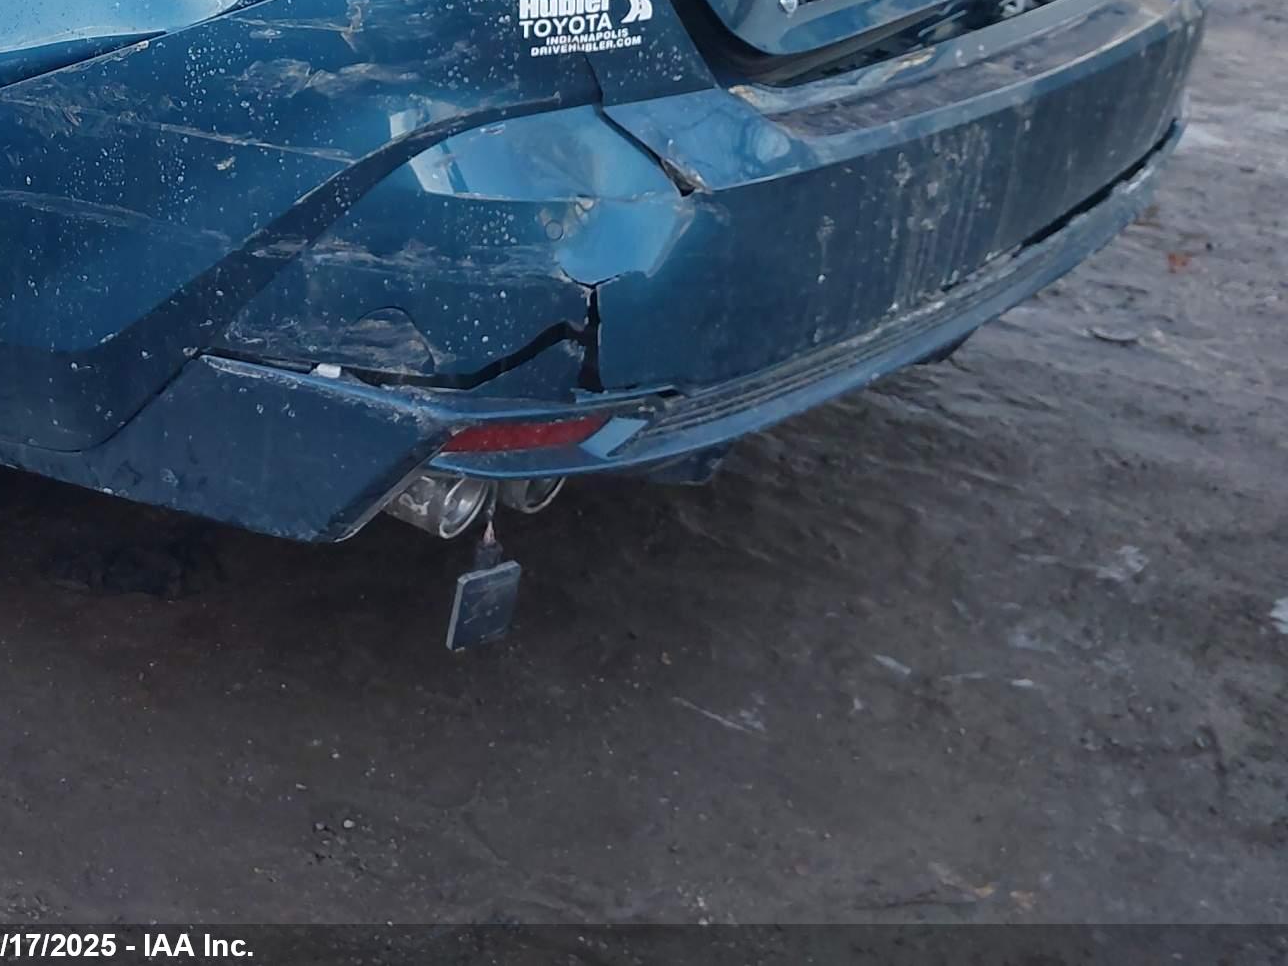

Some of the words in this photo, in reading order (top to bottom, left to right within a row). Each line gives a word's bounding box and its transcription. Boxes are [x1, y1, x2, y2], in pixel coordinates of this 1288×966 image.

[519, 12, 612, 39] TOYOTA
[546, 27, 629, 46] INDIANAPOLIS
[530, 35, 642, 57] DRIVEHUBLER.COM
